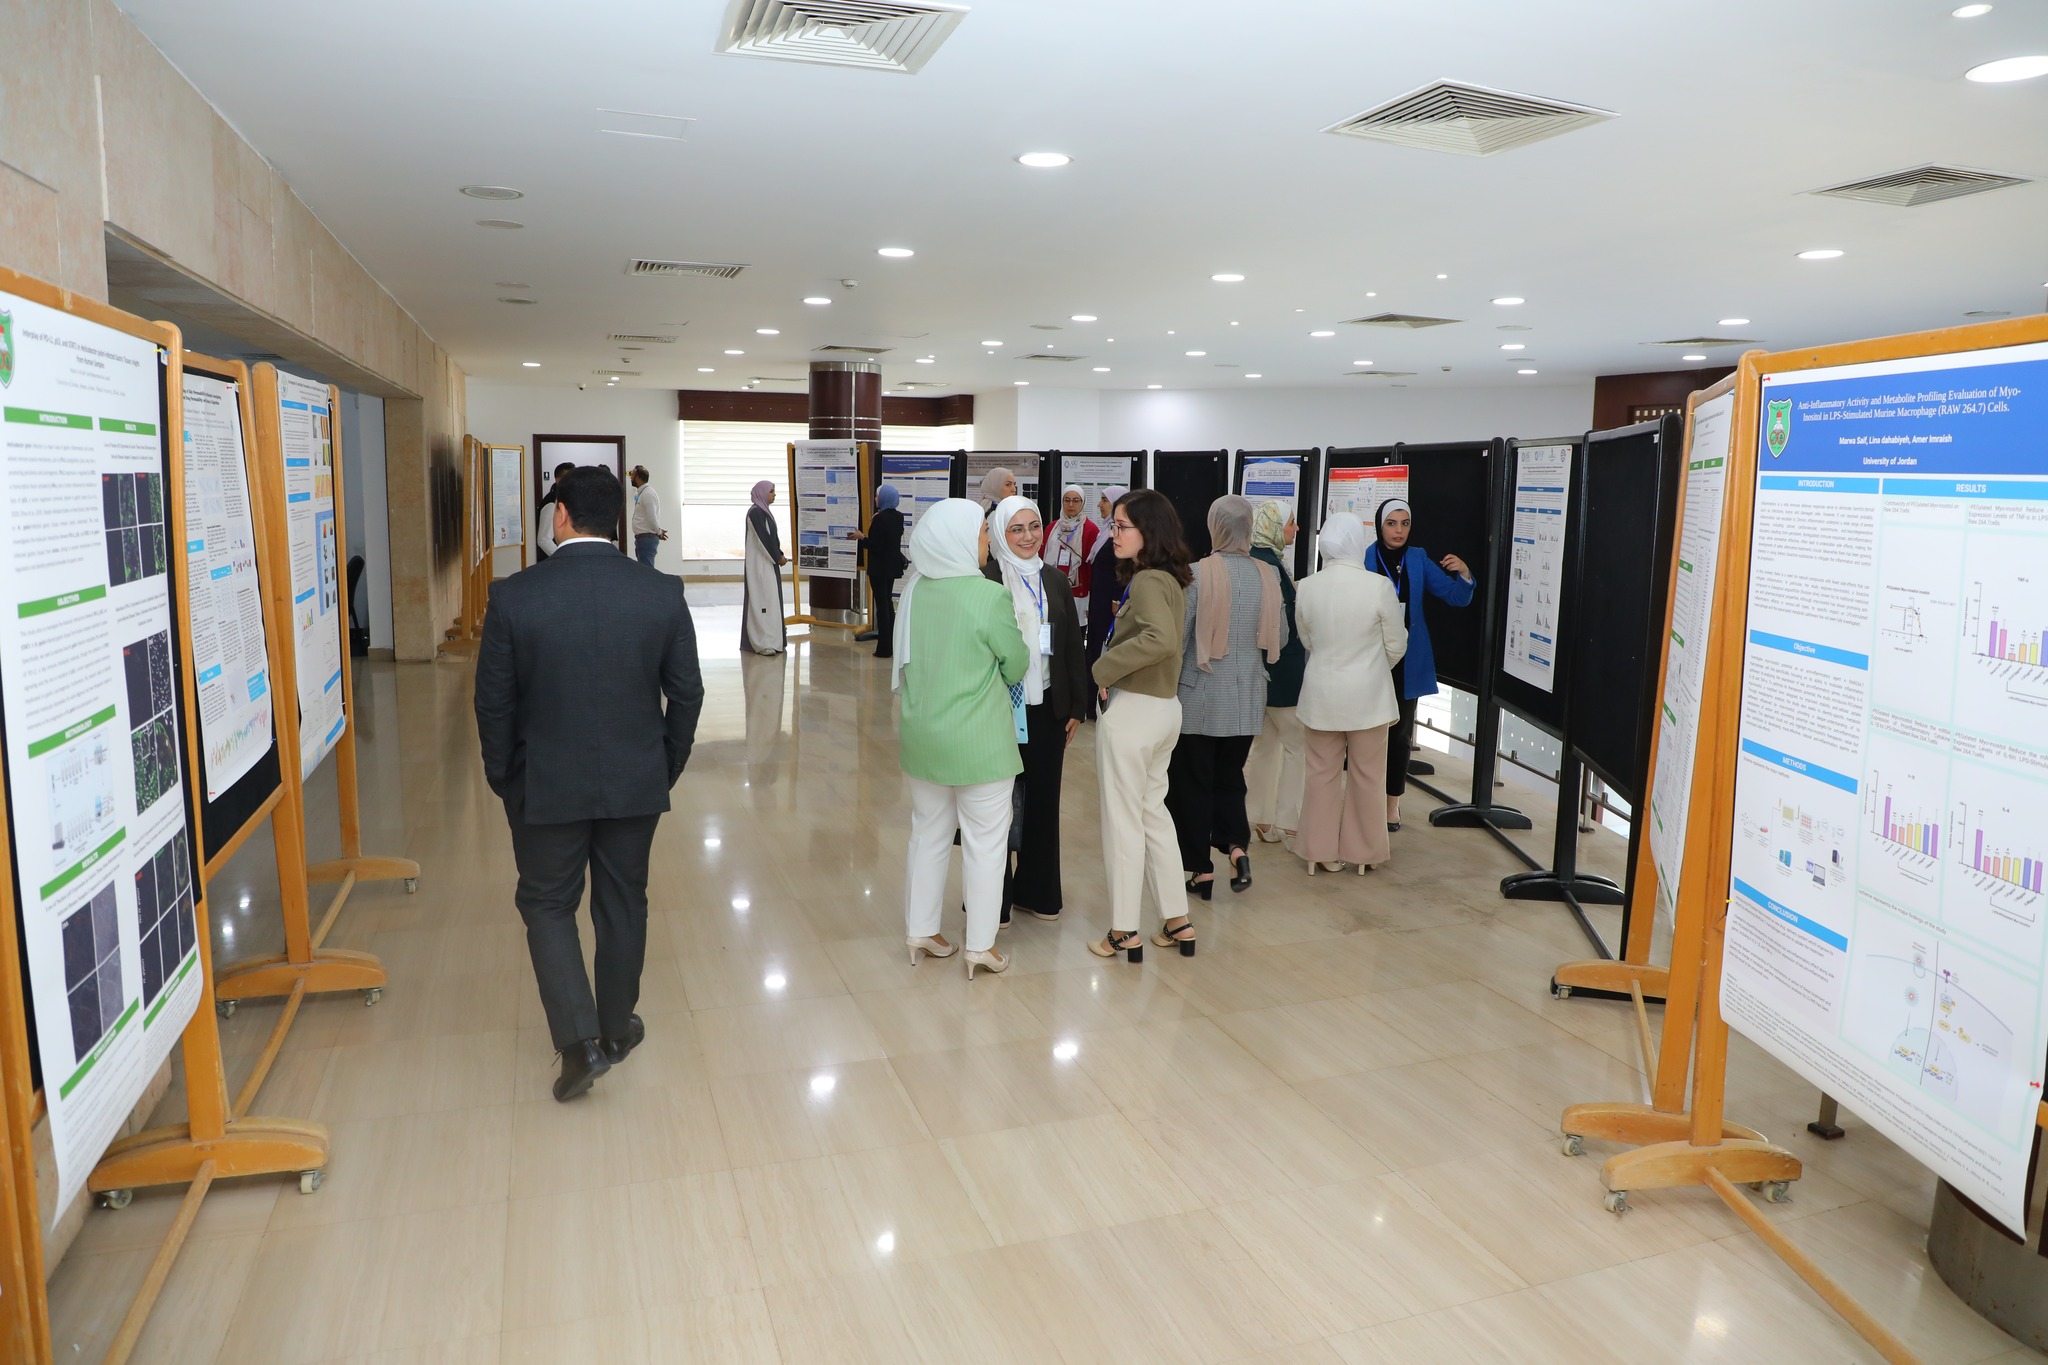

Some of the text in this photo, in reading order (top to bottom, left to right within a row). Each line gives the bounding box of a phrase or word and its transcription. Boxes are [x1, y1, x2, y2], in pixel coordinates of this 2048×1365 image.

[1798, 400, 1846, 410] Anti-Inflammatory
[1847, 397, 1869, 408] Activity
[1870, 395, 1882, 404] and
[1882, 393, 1916, 404] Metabolite
[1917, 391, 1946, 403] Profiling
[1948, 389, 1986, 400] Evaluation
[1988, 386, 1998, 398] of
[1999, 386, 2021, 399] Myo-
[1803, 401, 2010, 422] Inositol in LPS-Stimulated Murine Macrophage (RAW 264.7) Cells.
[1839, 437, 1856, 445] Marwa
[1857, 436, 1868, 446] Saif,
[1869, 436, 1880, 444] Lina
[1912, 434, 1928, 444] Amer
[1929, 434, 1952, 444] Imraish
[1863, 456, 1918, 467] University of Jordan
[1797, 480, 1835, 488] INTRODUCTION
[1956, 484, 1987, 493] RESULTS
[1793, 642, 1816, 654] Objective
[1782, 756, 1807, 771] METHODS
[1767, 901, 1799, 923] CONCLUSION
